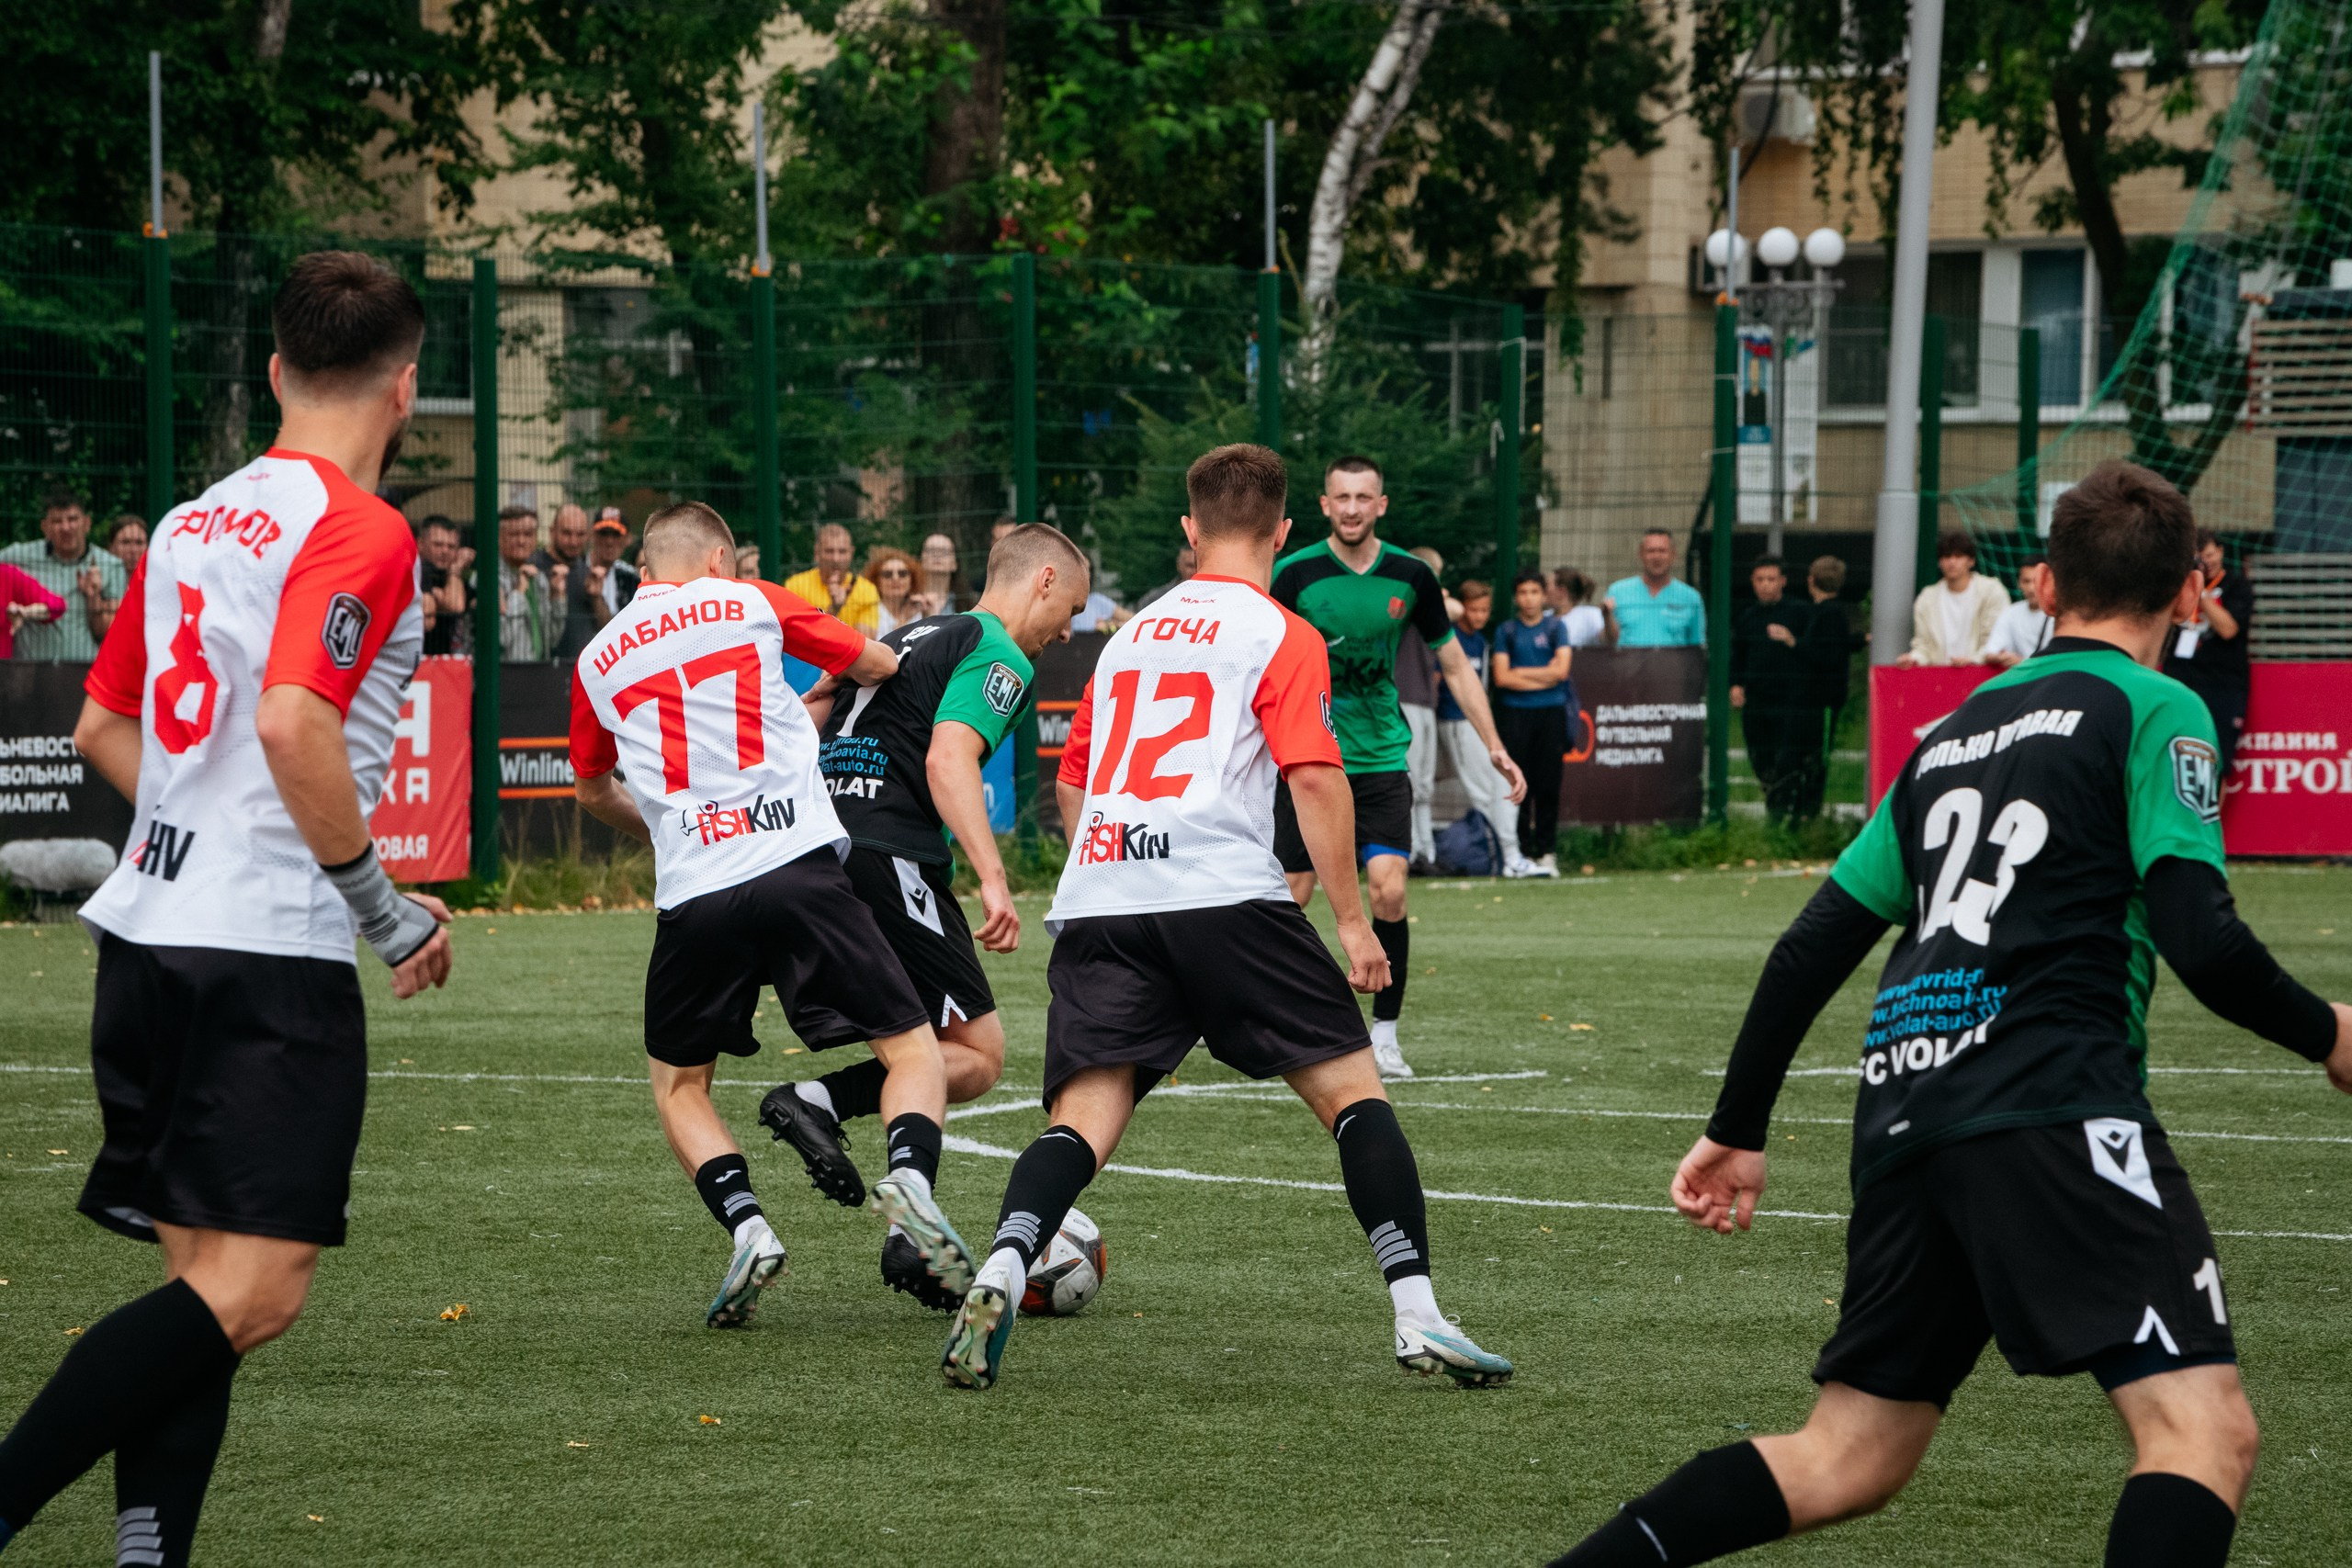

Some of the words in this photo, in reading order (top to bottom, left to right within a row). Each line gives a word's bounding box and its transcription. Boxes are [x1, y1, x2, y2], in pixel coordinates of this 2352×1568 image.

[594, 600, 744, 676] ШАБАНОВ
[1133, 617, 1220, 645] ГОЧА
[612, 642, 764, 795] 77
[1091, 670, 1215, 802] 12
[372, 835, 429, 862] ОВАЯ
[1917, 787, 2049, 946] 23
